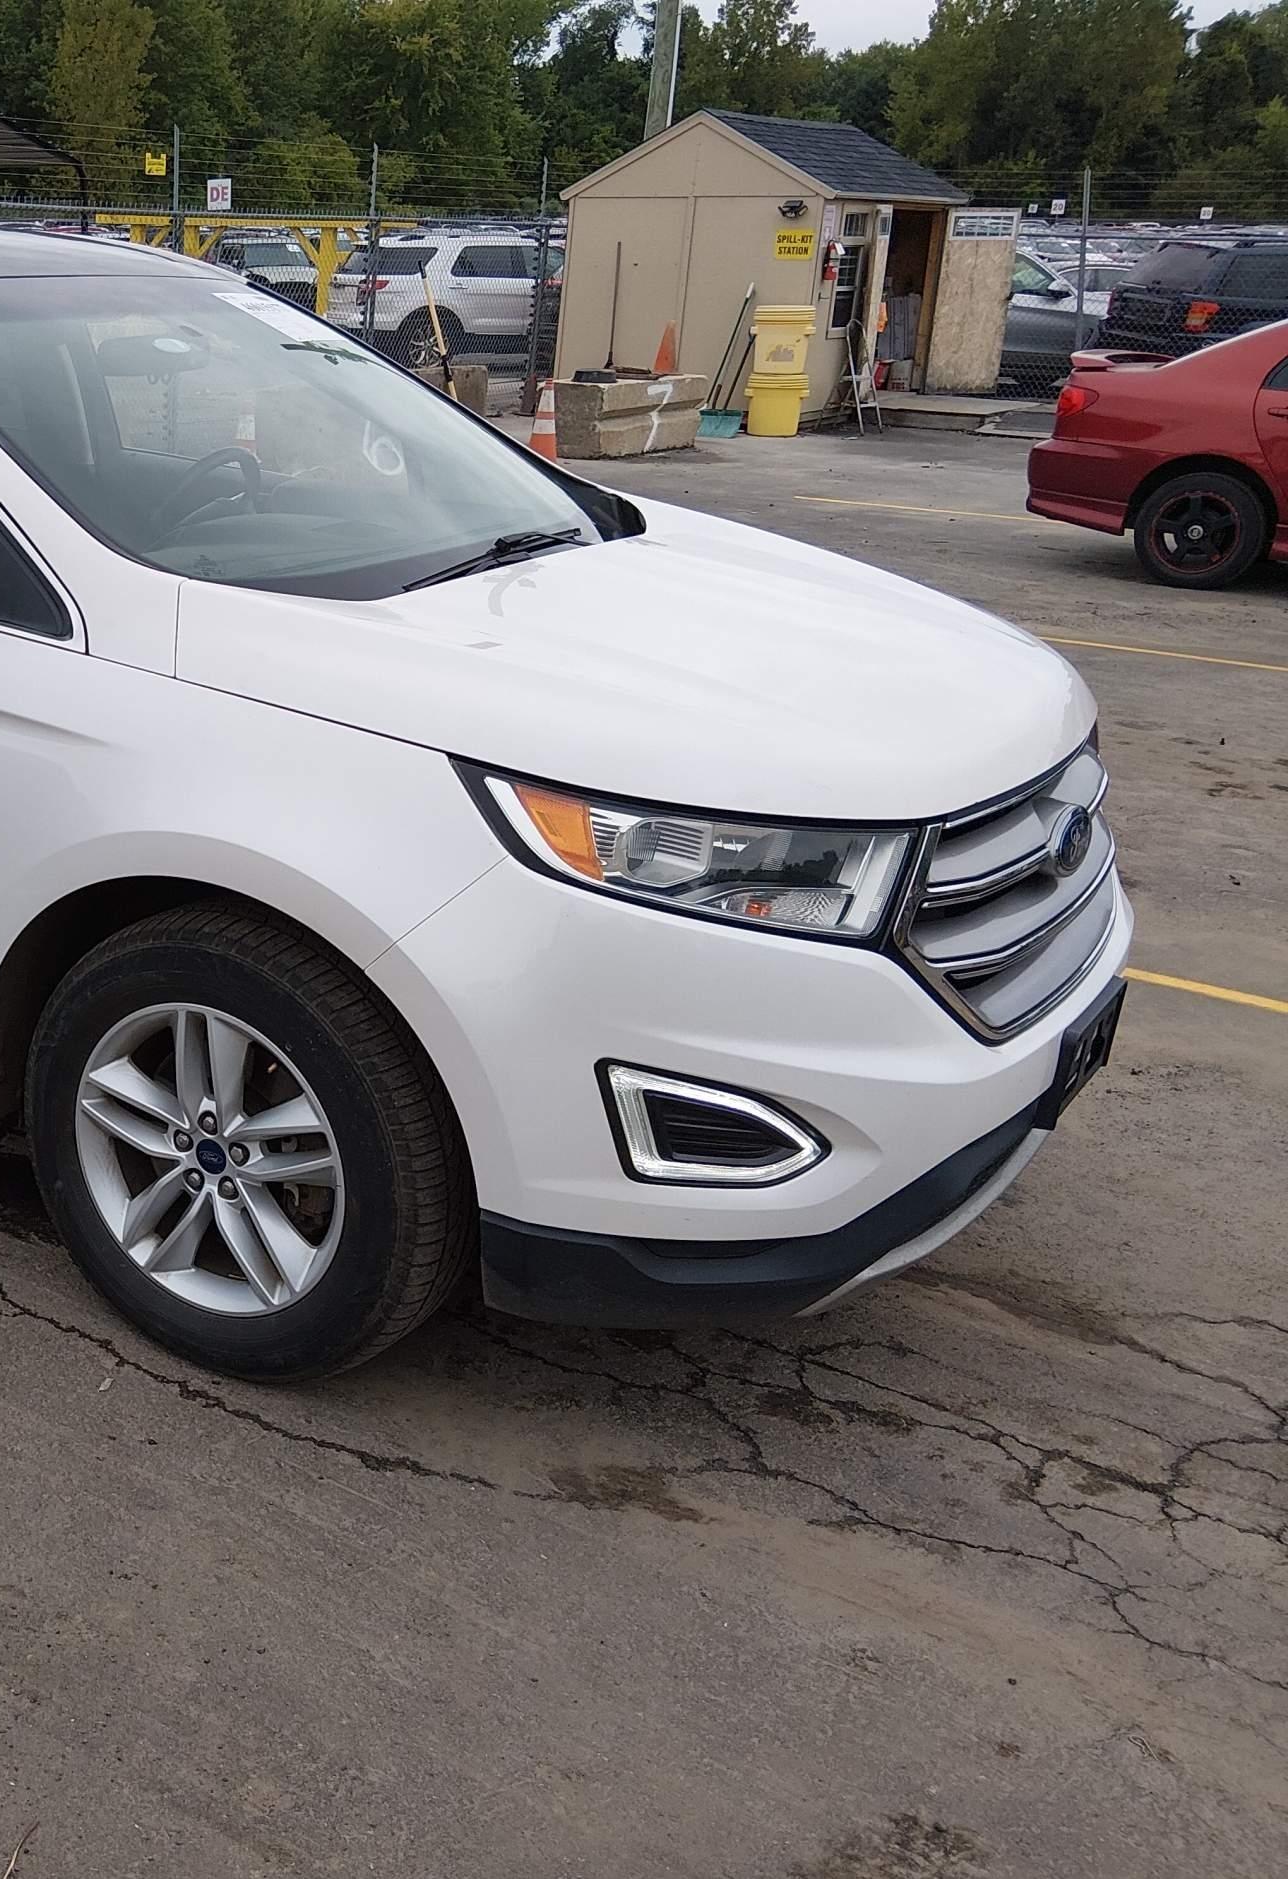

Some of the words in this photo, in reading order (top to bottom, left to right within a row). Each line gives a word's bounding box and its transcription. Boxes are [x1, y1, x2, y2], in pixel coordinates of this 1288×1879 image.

[210, 186, 229, 202] DE
[1053, 203, 1063, 211] 20
[777, 234, 813, 243] SPILL-KIT
[778, 246, 809, 255] STATION
